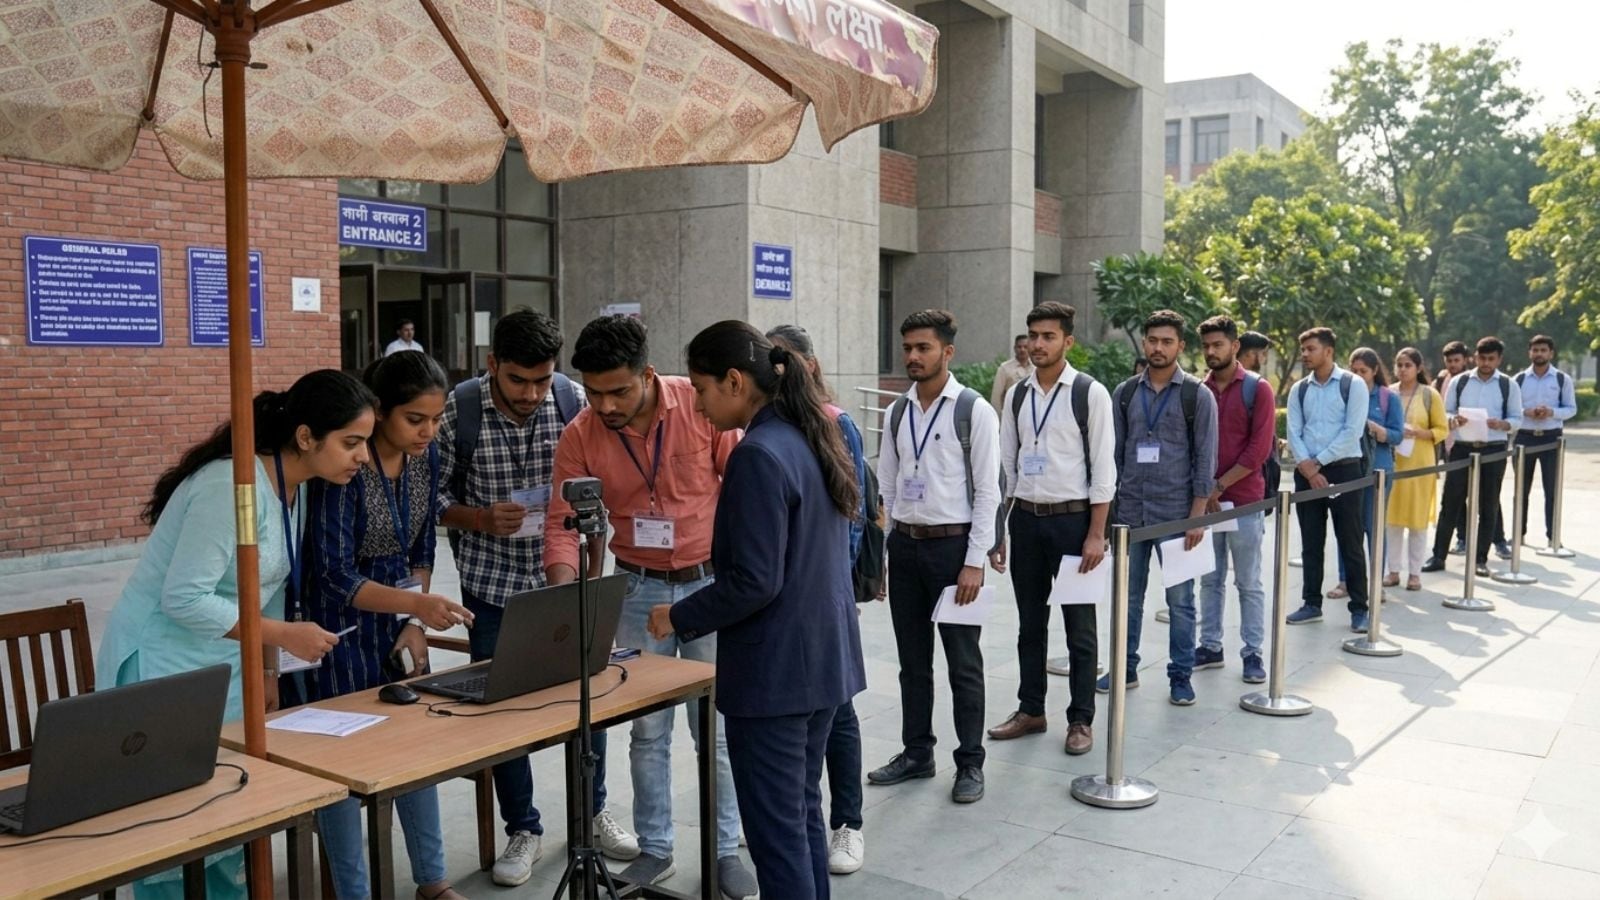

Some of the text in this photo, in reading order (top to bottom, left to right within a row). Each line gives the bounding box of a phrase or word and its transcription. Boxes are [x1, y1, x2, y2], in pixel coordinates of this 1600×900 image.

[413, 215, 422, 228] 2
[343, 225, 422, 245] ENTRANCE 2
